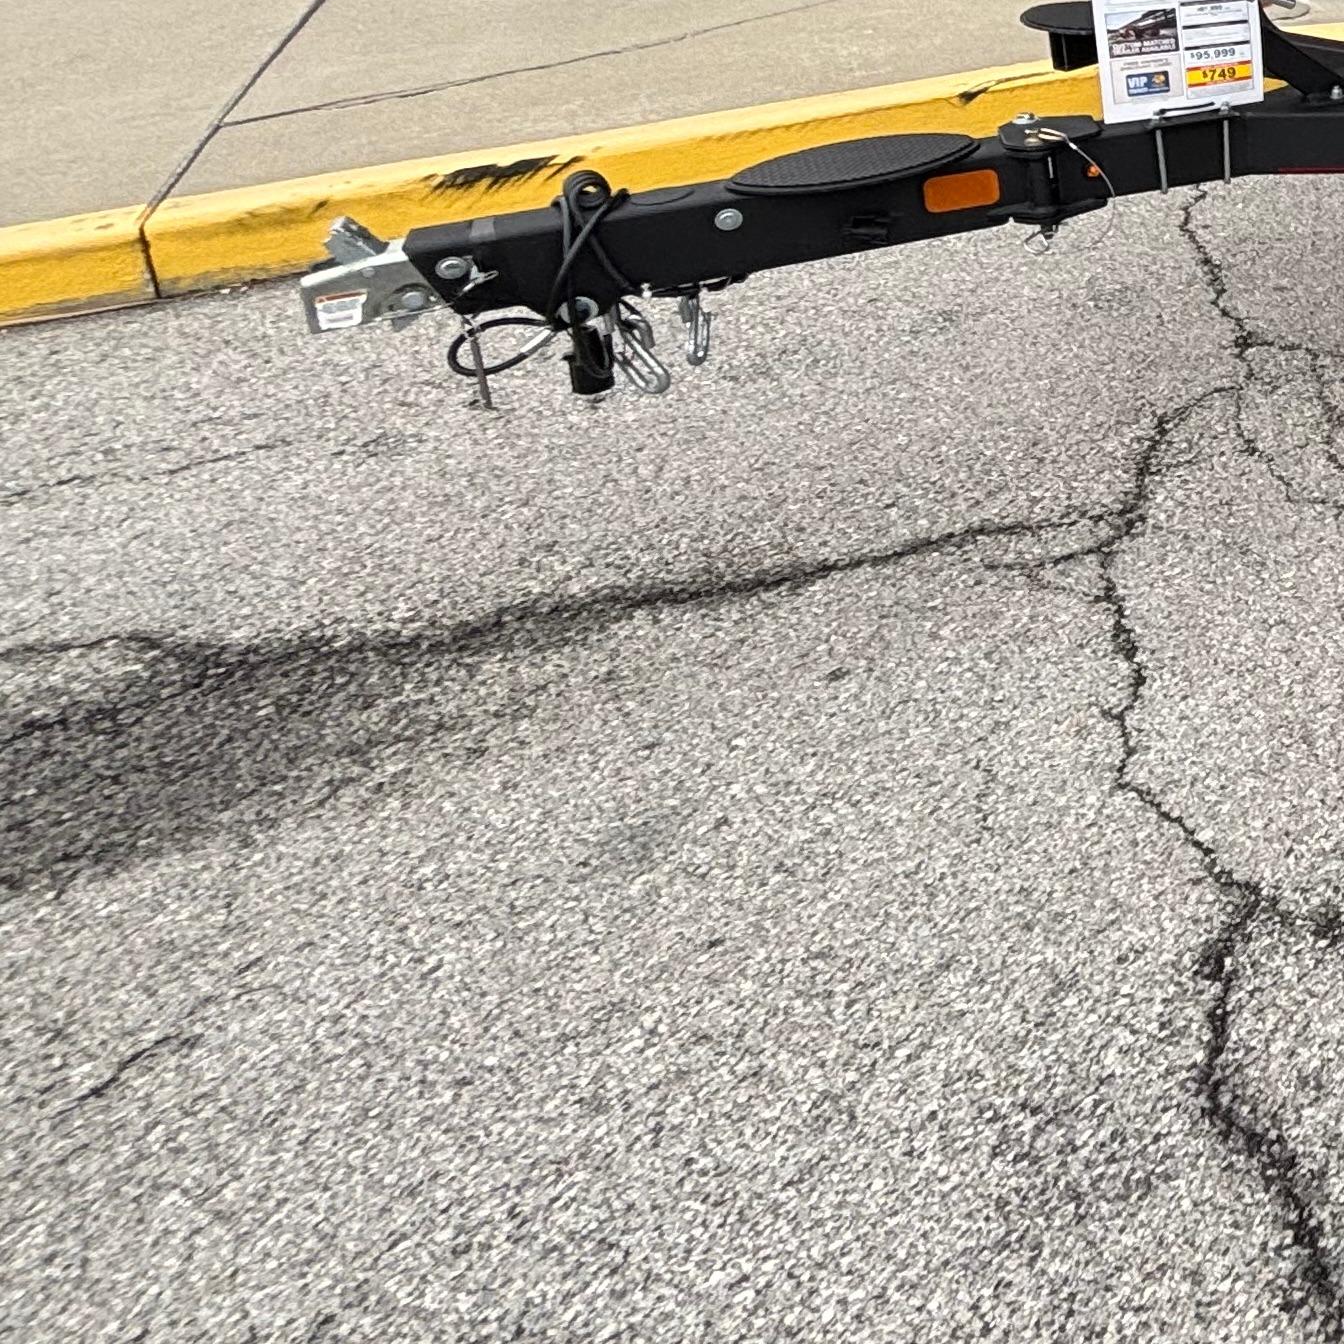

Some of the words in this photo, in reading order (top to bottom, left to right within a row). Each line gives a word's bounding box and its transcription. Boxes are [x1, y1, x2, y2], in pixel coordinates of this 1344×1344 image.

[1190, 48, 1236, 61] $95,999
[1202, 67, 1236, 81] $749
[1128, 76, 1148, 89] VIP
